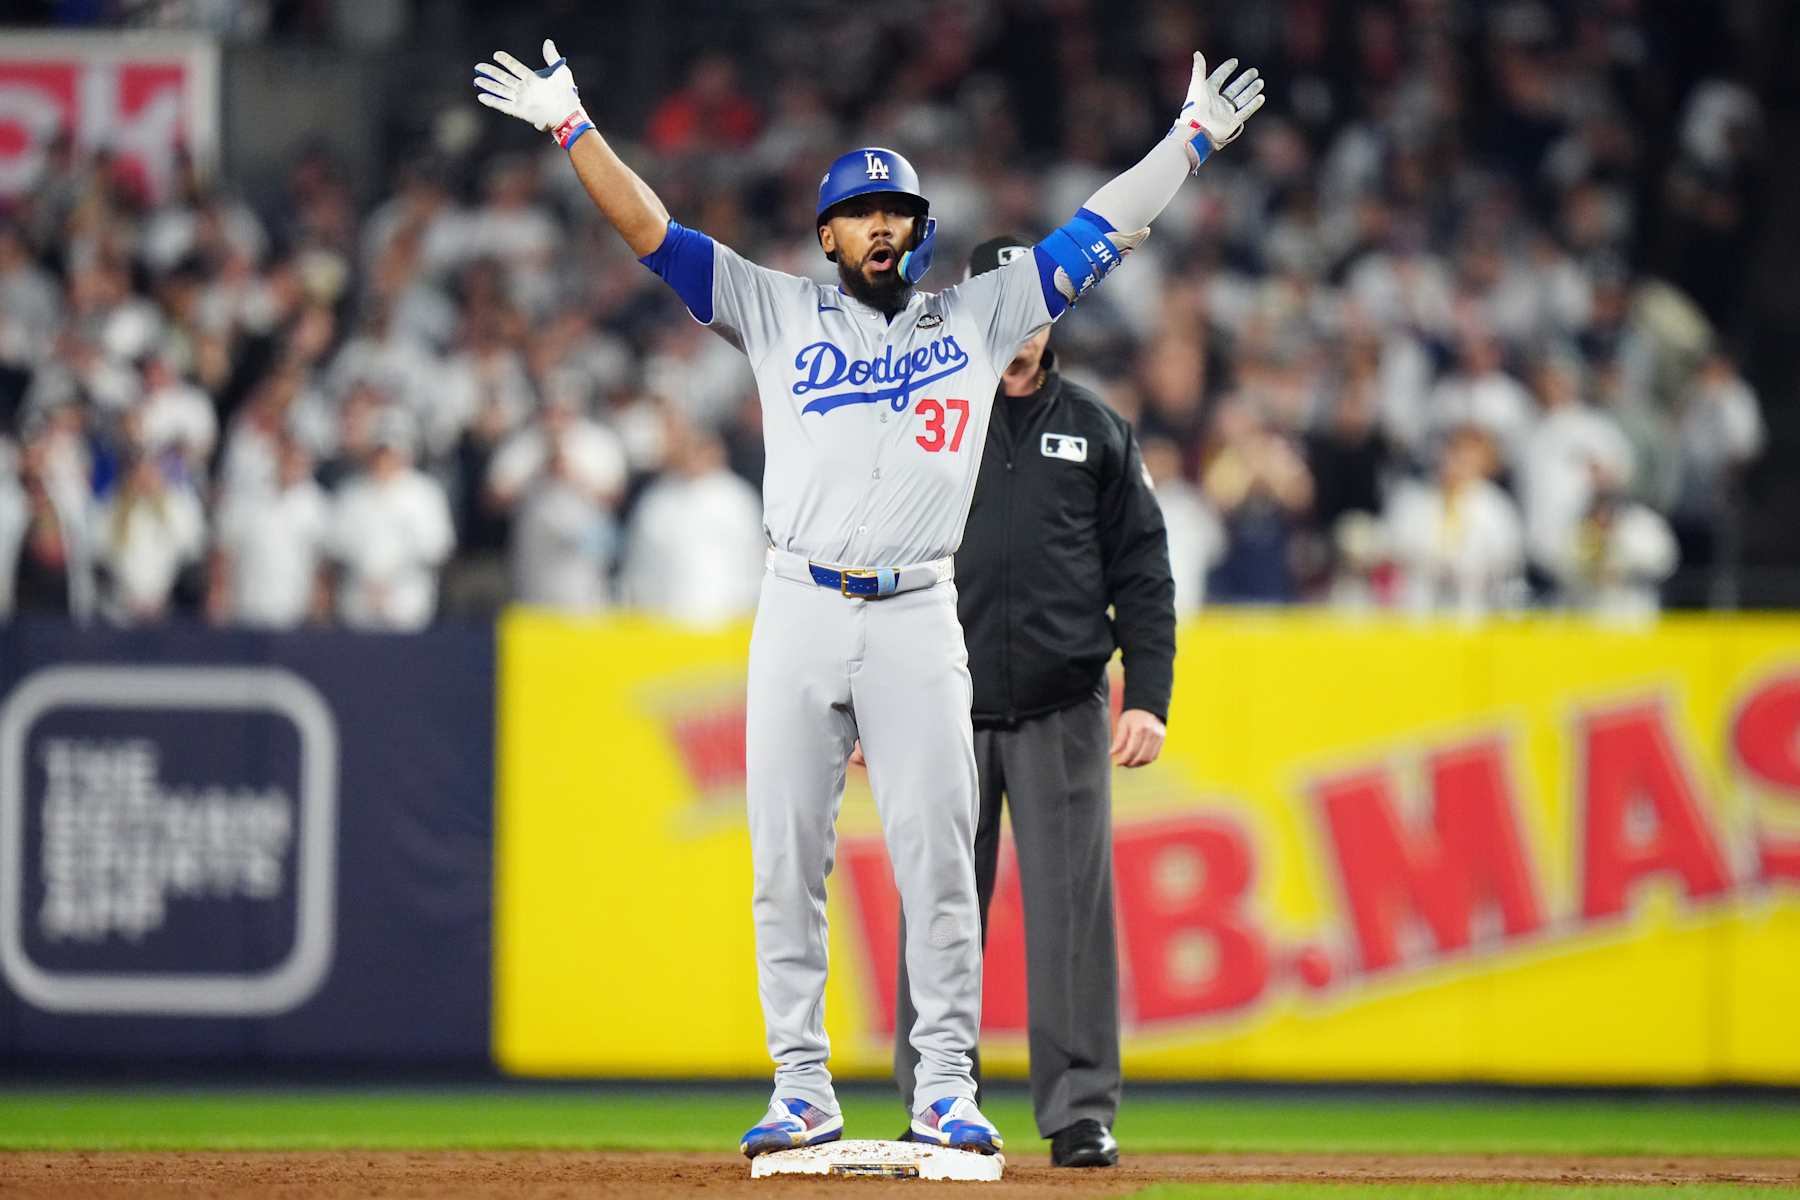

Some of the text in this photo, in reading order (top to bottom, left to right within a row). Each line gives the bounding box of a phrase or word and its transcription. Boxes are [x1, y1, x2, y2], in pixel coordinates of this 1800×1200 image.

[864, 151, 890, 180] LA
[792, 335, 969, 416] Dodgers
[914, 398, 970, 453] 37
